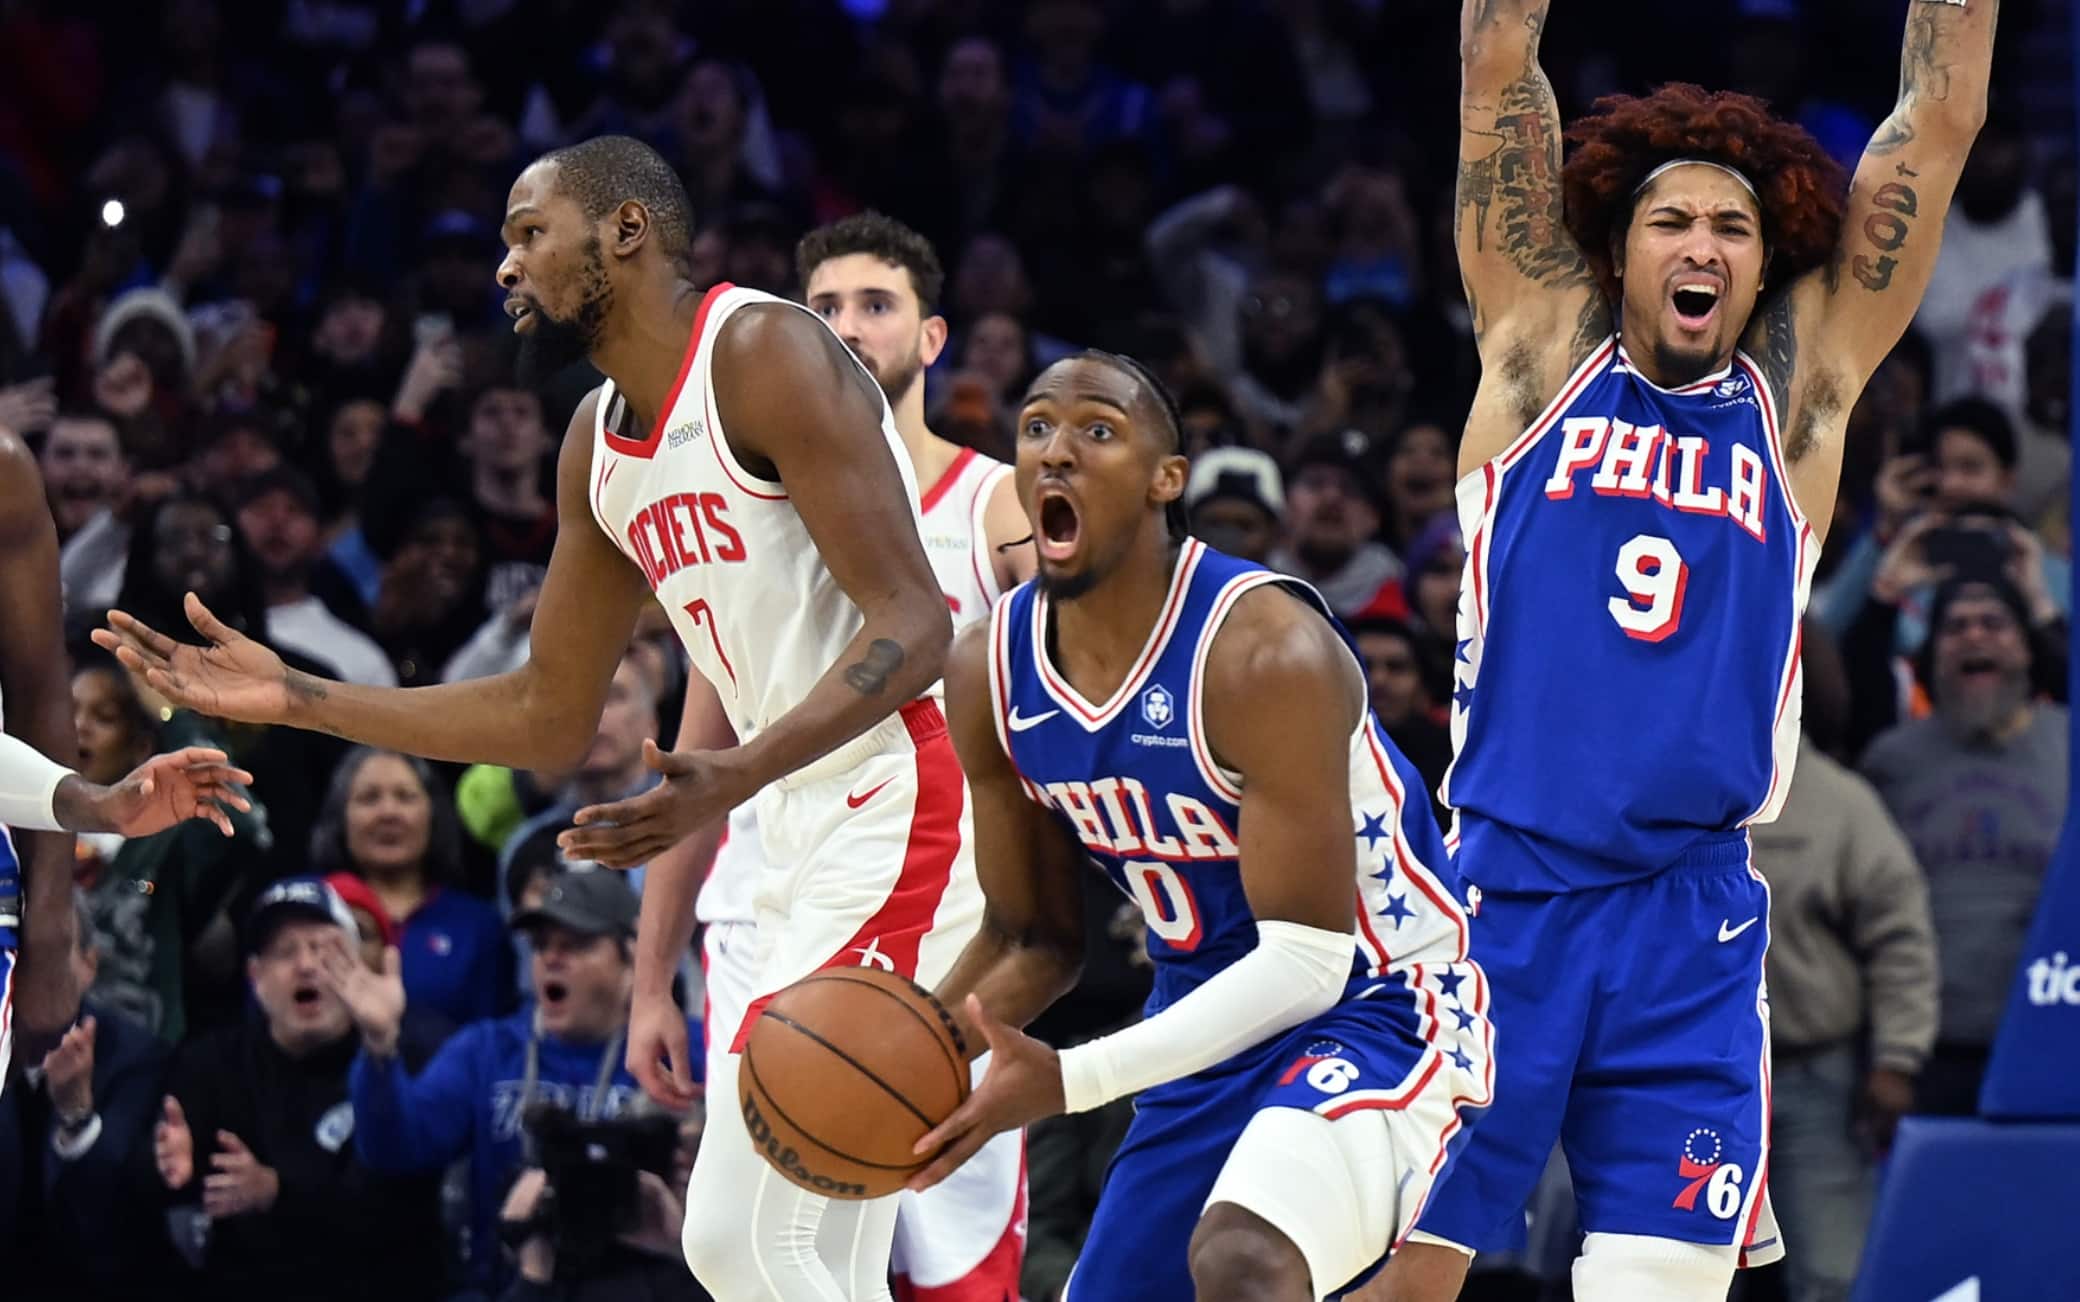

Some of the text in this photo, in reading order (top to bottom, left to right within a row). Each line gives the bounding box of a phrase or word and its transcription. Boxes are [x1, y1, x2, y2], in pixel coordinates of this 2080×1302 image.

[1544, 416, 1767, 544] PHILA
[627, 491, 747, 593] OCKETS
[1608, 534, 1689, 643] 9
[683, 598, 738, 698] 7
[1131, 733, 1189, 747] crypto.com
[1045, 776, 1240, 862] HILA
[1123, 860, 1203, 952] 0
[1277, 1056, 1360, 1095] 76
[744, 1089, 867, 1195] Wilson
[1672, 1154, 1743, 1219] 76
